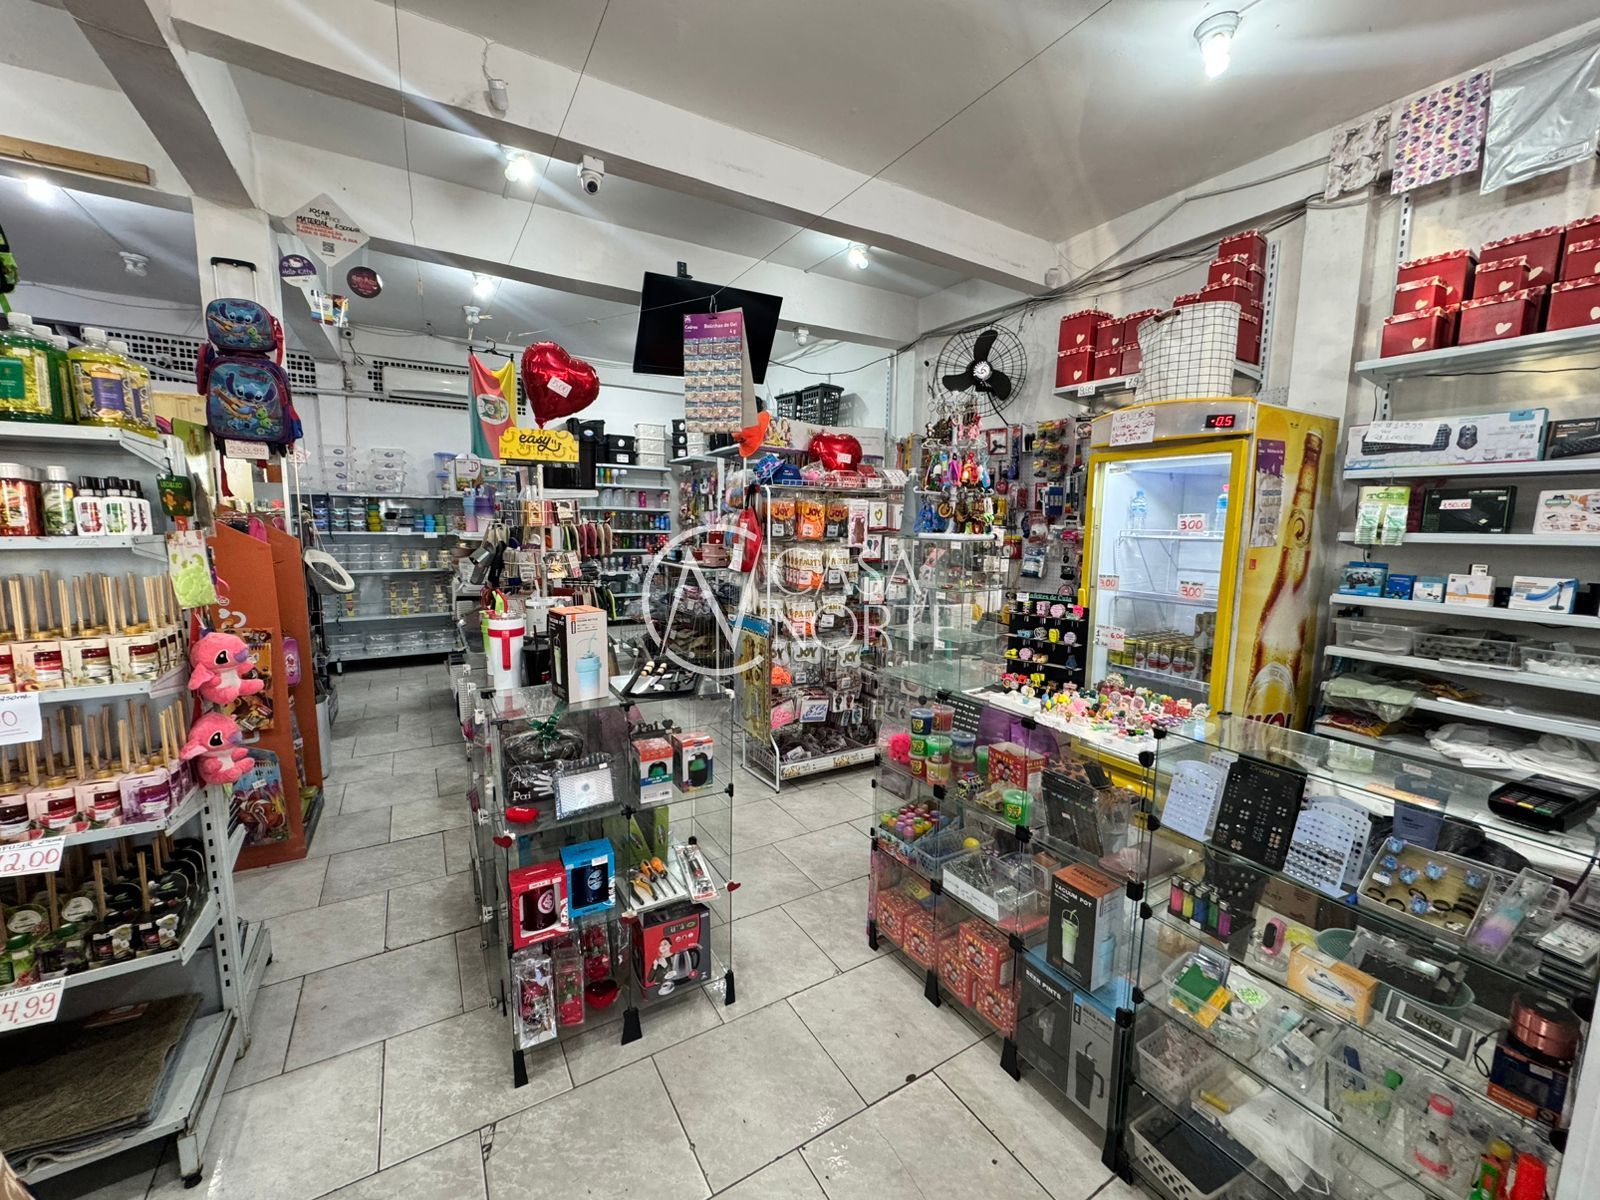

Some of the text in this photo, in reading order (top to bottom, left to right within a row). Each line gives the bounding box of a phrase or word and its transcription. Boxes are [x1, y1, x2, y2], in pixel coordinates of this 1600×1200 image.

[518, 433, 562, 453] easy
[775, 507, 790, 517] JOY
[805, 507, 821, 517] JOY
[829, 509, 845, 518] JOY
[795, 647, 818, 659] JOY
[512, 790, 532, 801] Pai
[1053, 880, 1093, 908] VACUUM POT
